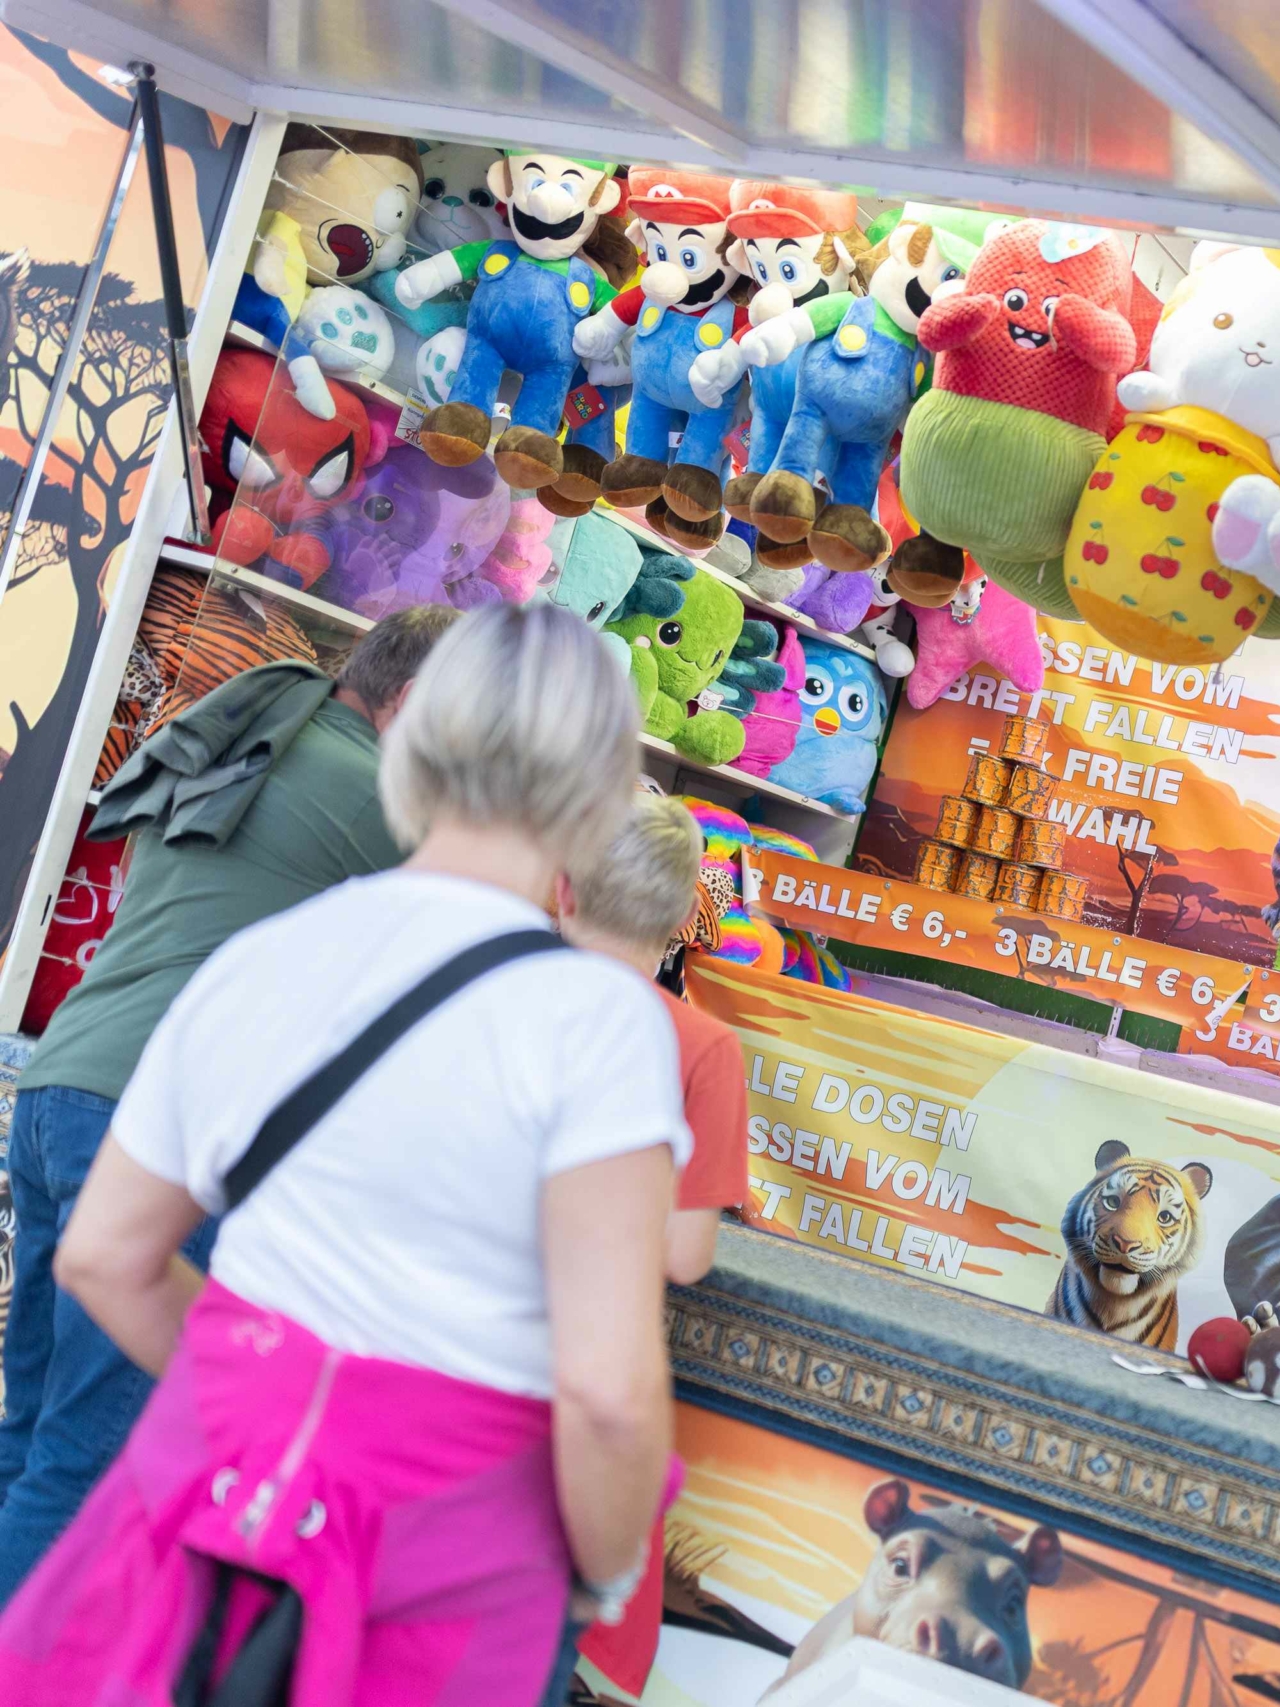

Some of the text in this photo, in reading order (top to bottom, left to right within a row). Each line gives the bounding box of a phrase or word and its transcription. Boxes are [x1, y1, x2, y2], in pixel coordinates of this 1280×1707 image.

[1038, 634, 1246, 710] SSEN VOM
[940, 671, 1245, 764] BRETT FALLEN
[1062, 748, 1184, 805] FREIE
[1049, 799, 1158, 855] WAHL
[772, 873, 882, 923] BÄLLE
[890, 903, 913, 931] €
[922, 910, 967, 947] 6,-
[995, 928, 1017, 957] 3
[1027, 933, 1148, 989] BÄLLE
[1156, 968, 1181, 997] €
[744, 1054, 979, 1152] LE DOSEN
[748, 1115, 853, 1180] SSEN
[866, 1149, 972, 1215] VOM
[799, 1193, 969, 1279] FALLEN
